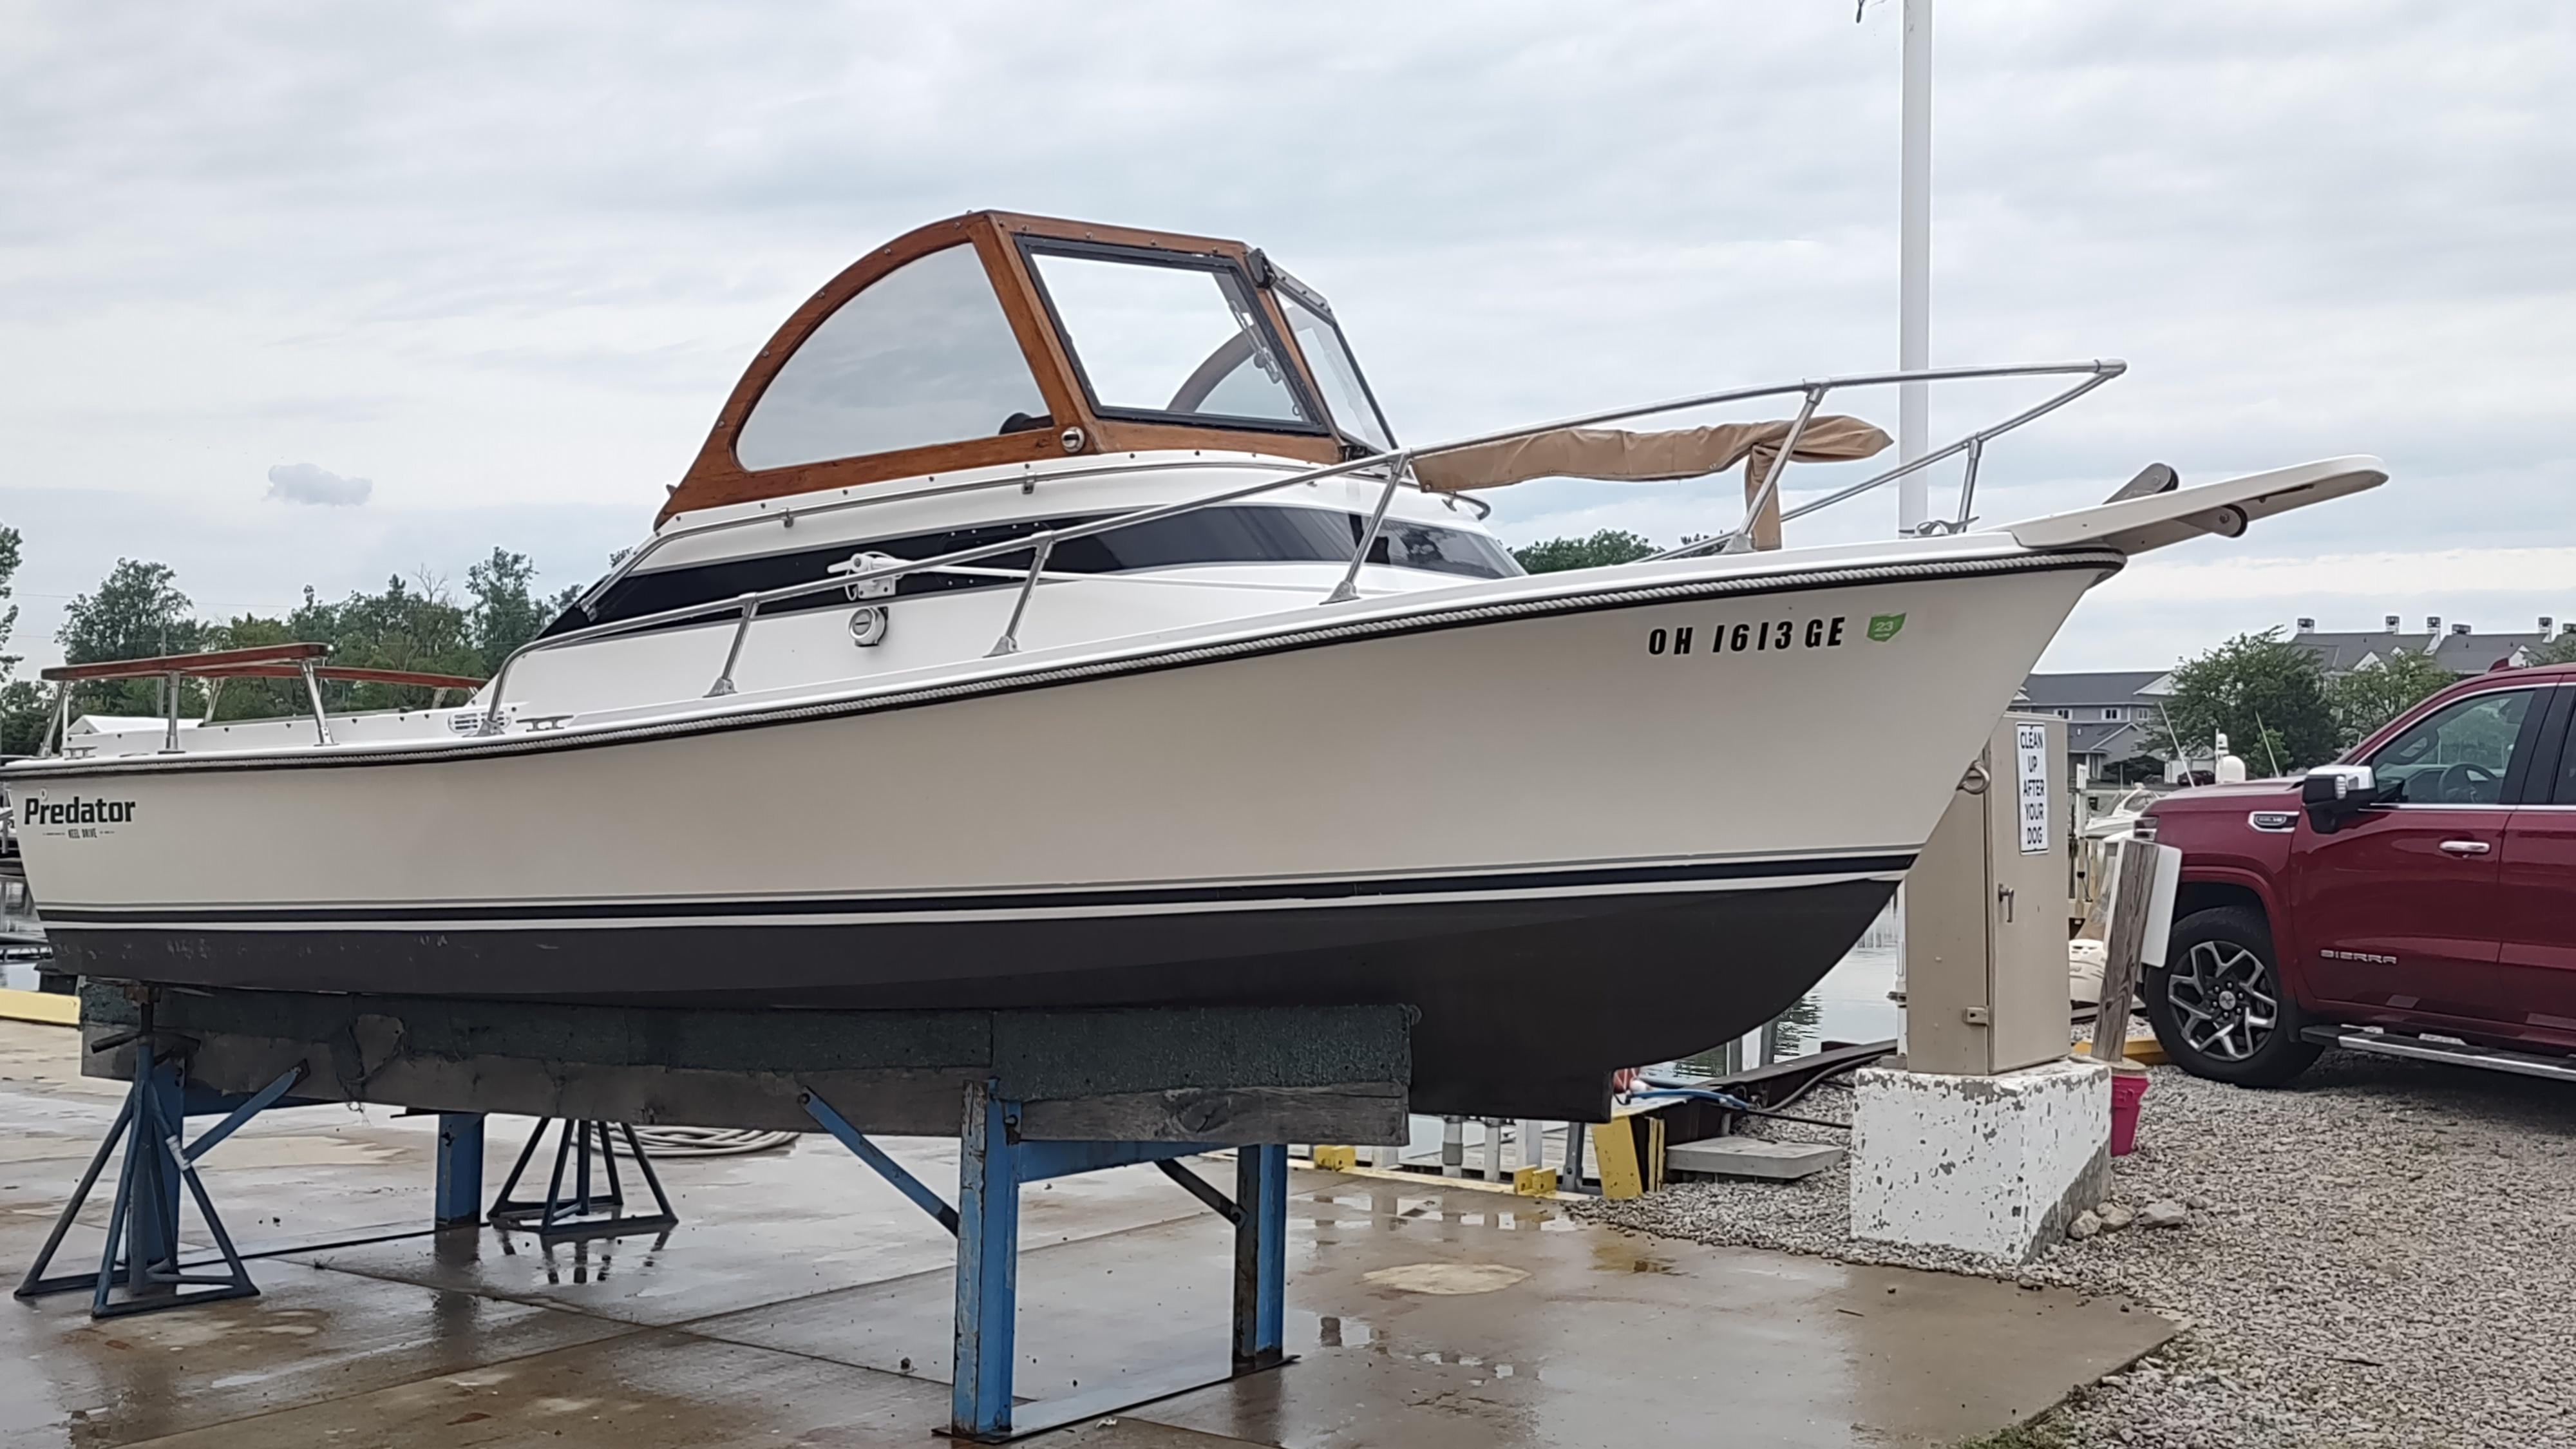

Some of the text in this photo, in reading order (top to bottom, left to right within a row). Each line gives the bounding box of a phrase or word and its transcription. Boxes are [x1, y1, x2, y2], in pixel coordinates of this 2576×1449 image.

[1875, 621, 1894, 632] 23
[1648, 617, 1846, 655] OH 1613 GE
[2020, 732, 2043, 749] CLEAN
[2028, 755, 2038, 773] UP
[2023, 779, 2045, 797] AFTER
[24, 796, 136, 825] Predator
[2025, 803, 2044, 820] YOUR
[2027, 827, 2043, 844] DOG
[2320, 949, 2397, 964] SIERRA
